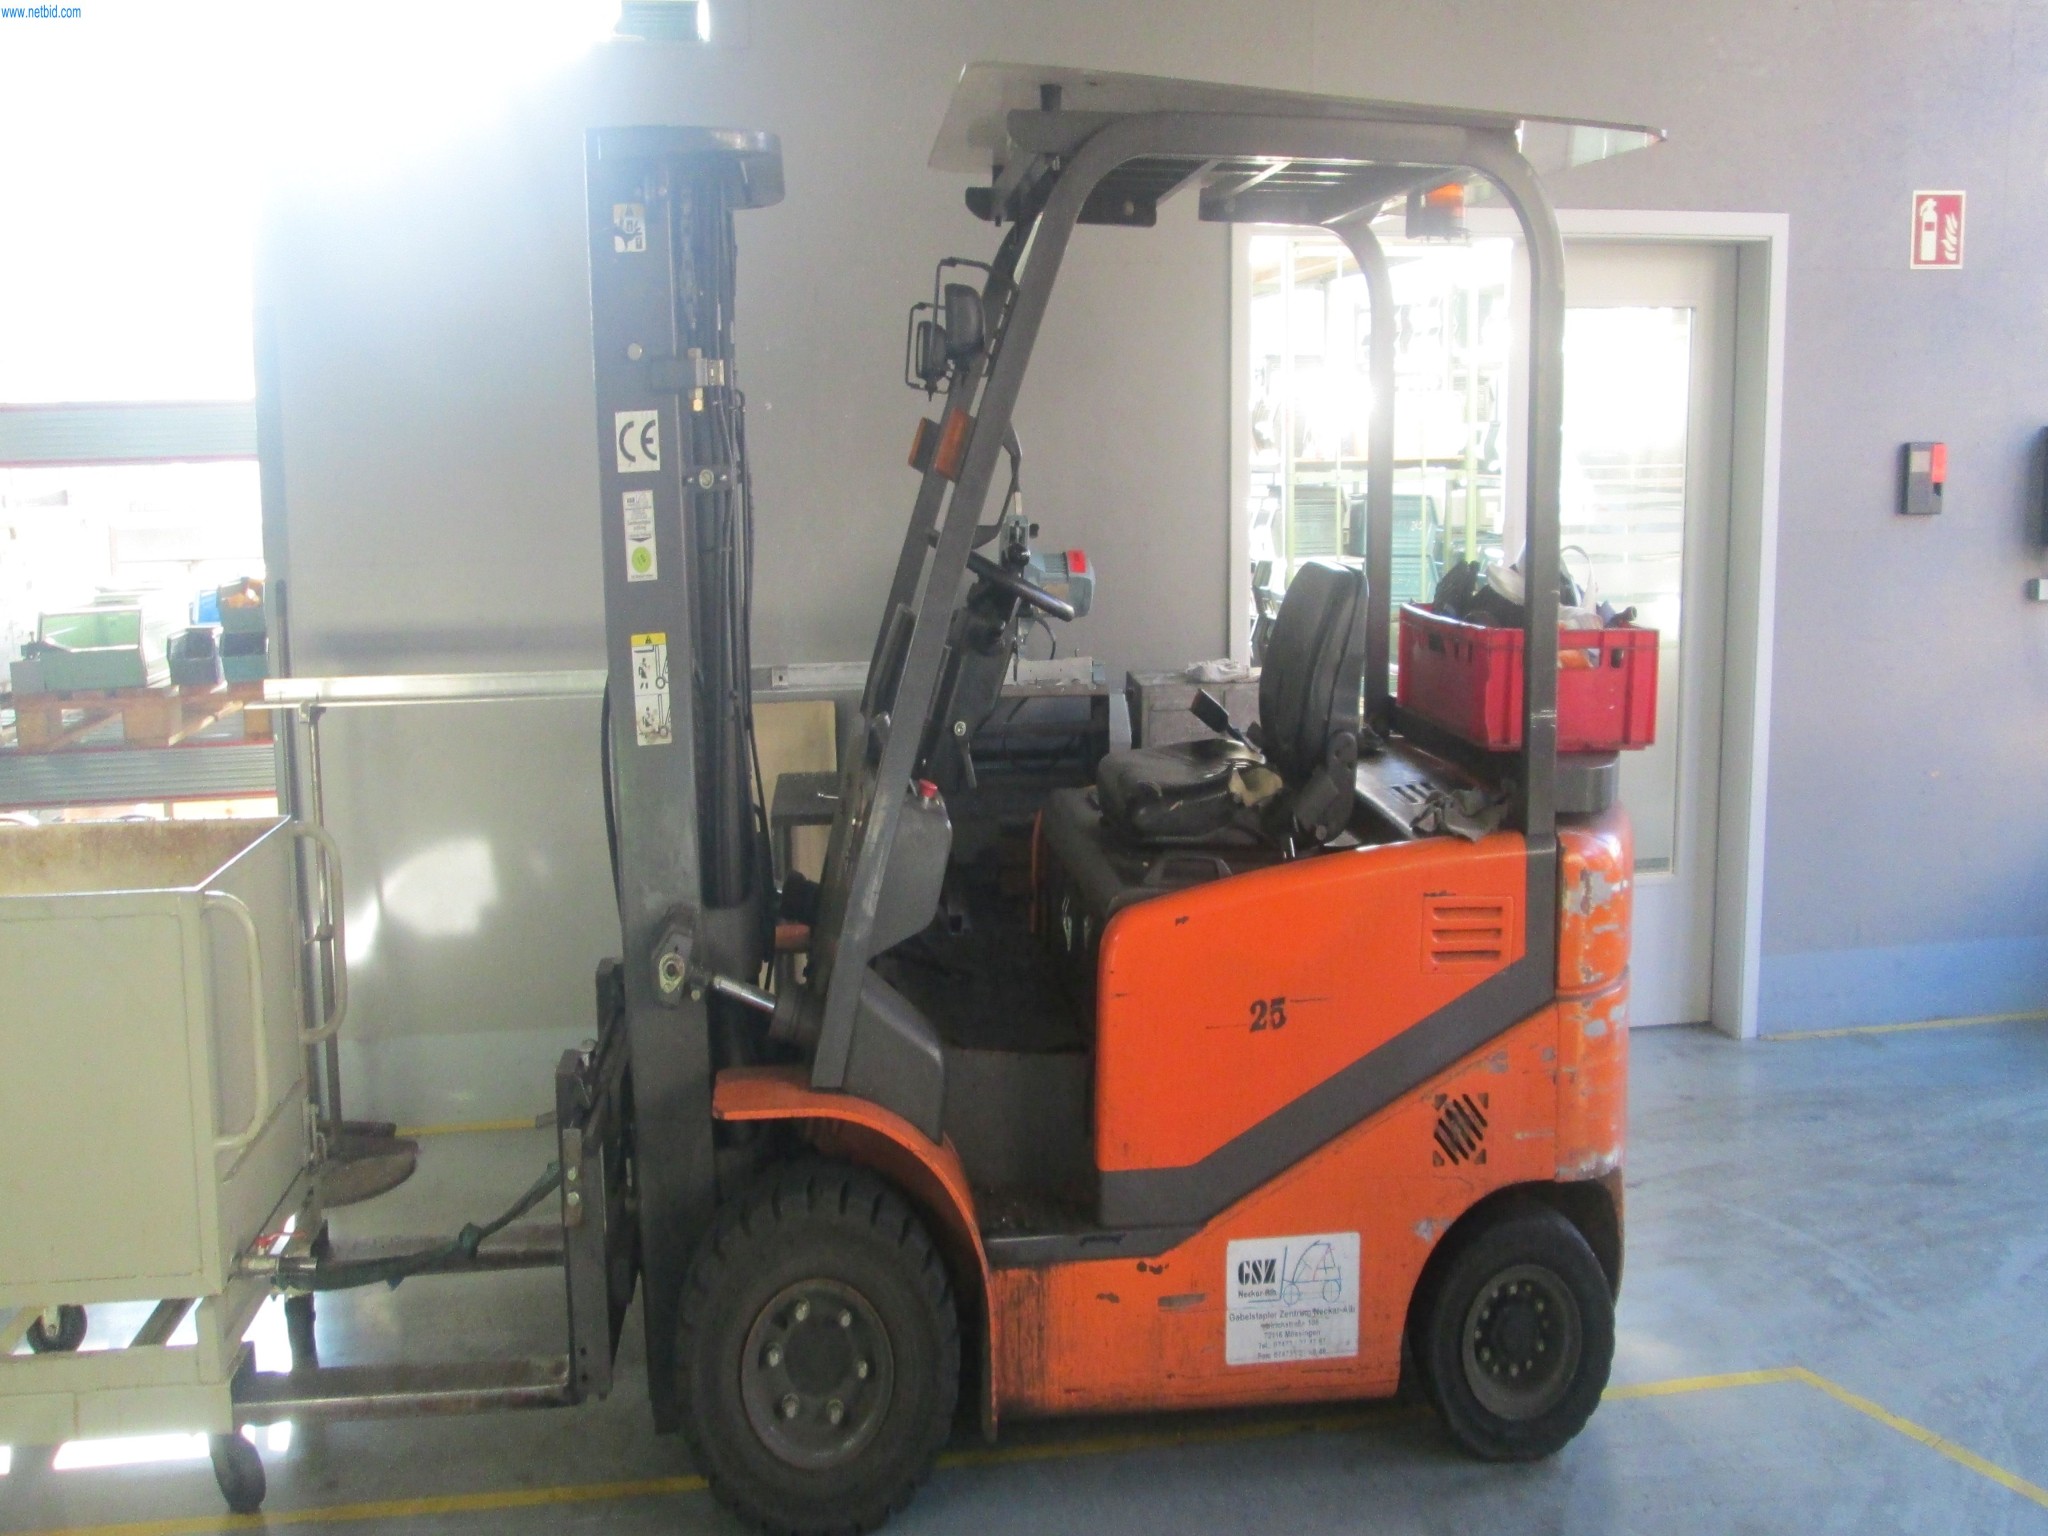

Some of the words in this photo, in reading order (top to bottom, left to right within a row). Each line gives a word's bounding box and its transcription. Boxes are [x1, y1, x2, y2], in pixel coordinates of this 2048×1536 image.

[1249, 997, 1287, 1034] 25
[1238, 1259, 1277, 1285] GSZ
[1229, 1311, 1278, 1321] Gabelstapler
